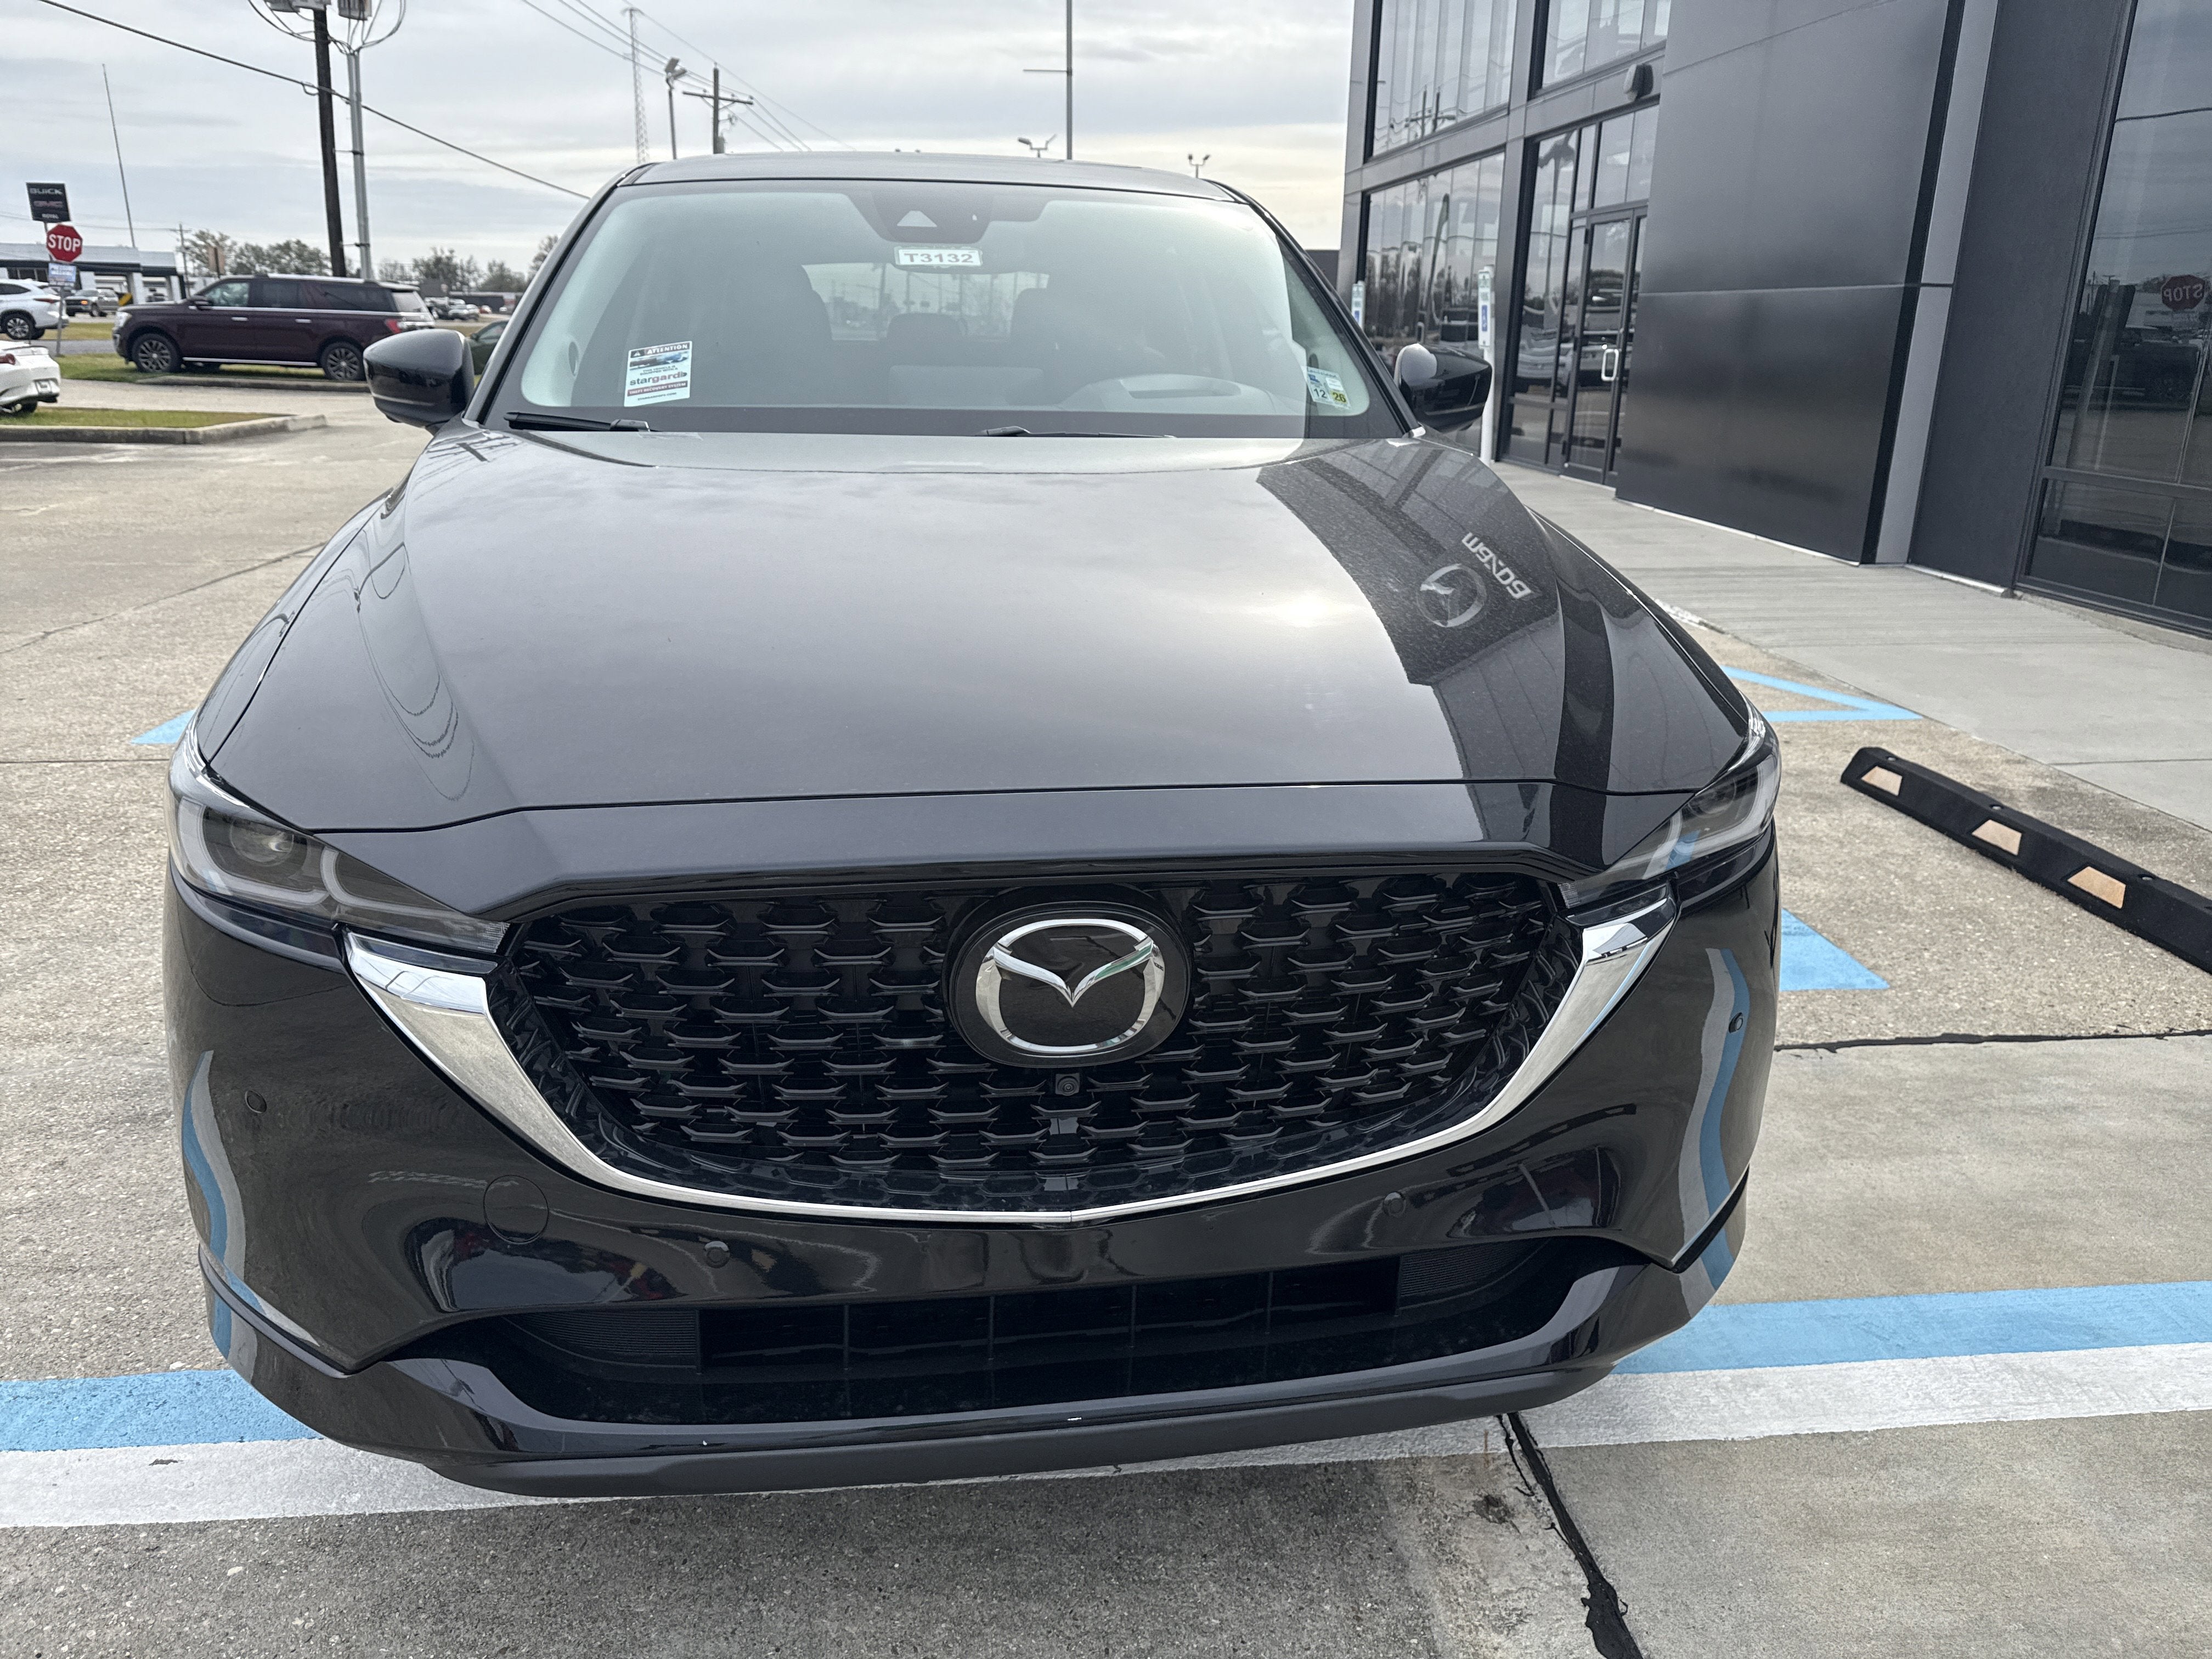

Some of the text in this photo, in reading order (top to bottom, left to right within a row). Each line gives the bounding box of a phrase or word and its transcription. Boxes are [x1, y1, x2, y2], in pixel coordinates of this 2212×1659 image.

[48, 234, 81, 252] STOP
[904, 253, 973, 263] T3132
[647, 343, 687, 354] ATTENTION
[630, 371, 681, 385] stargard
[1314, 388, 1327, 398] 12
[1332, 392, 1346, 403] 26
